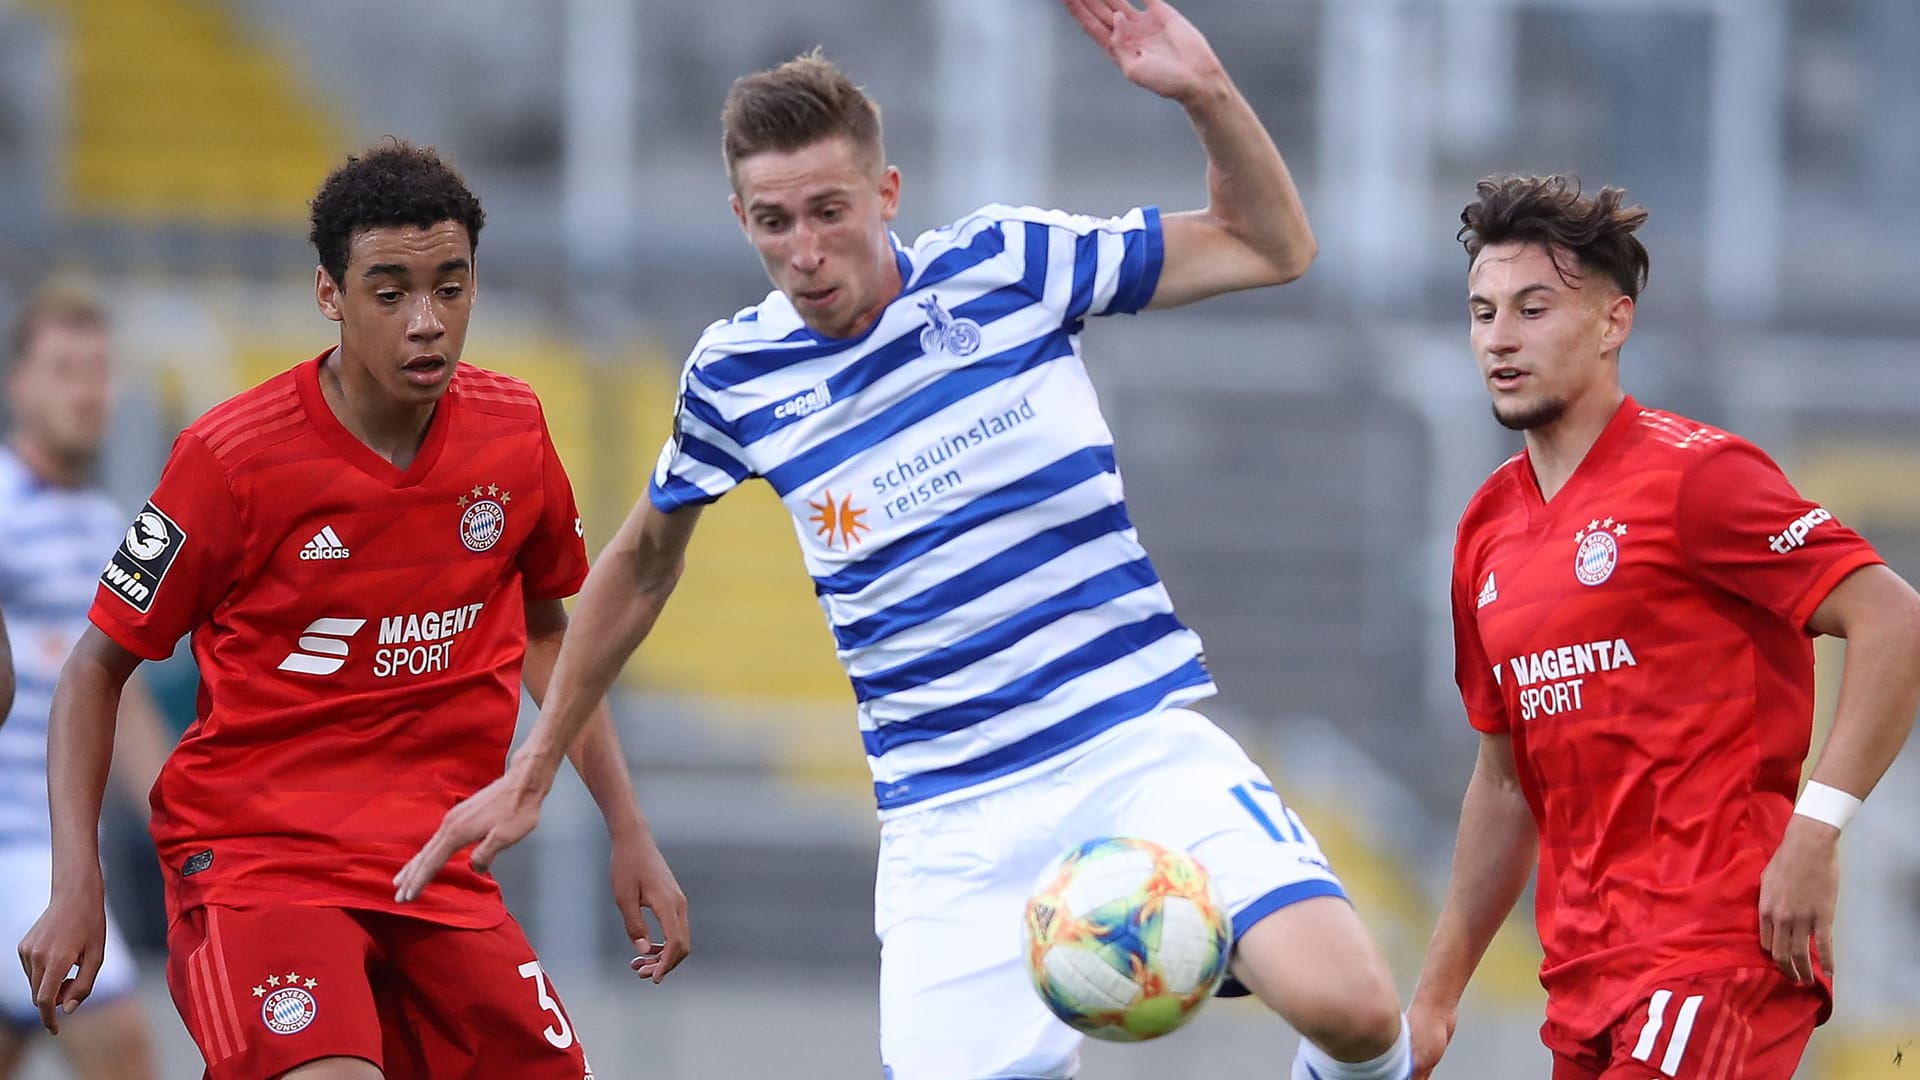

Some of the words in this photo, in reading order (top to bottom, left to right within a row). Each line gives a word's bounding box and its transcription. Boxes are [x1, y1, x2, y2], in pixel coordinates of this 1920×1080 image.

[872, 398, 1036, 495] schauinsland
[464, 510, 475, 524] FC
[474, 503, 502, 522] BAYERN
[883, 470, 962, 520] reisen
[300, 547, 350, 560] adidas
[1768, 508, 1832, 554] tipico
[373, 640, 453, 677] SPORT
[1511, 638, 1637, 687] MAGENTA
[1520, 679, 1584, 720] SPORT
[1229, 780, 1305, 842] 17
[266, 1000, 276, 1012] FC
[274, 991, 310, 1005] BAYERN
[1631, 989, 1704, 1078] 11
